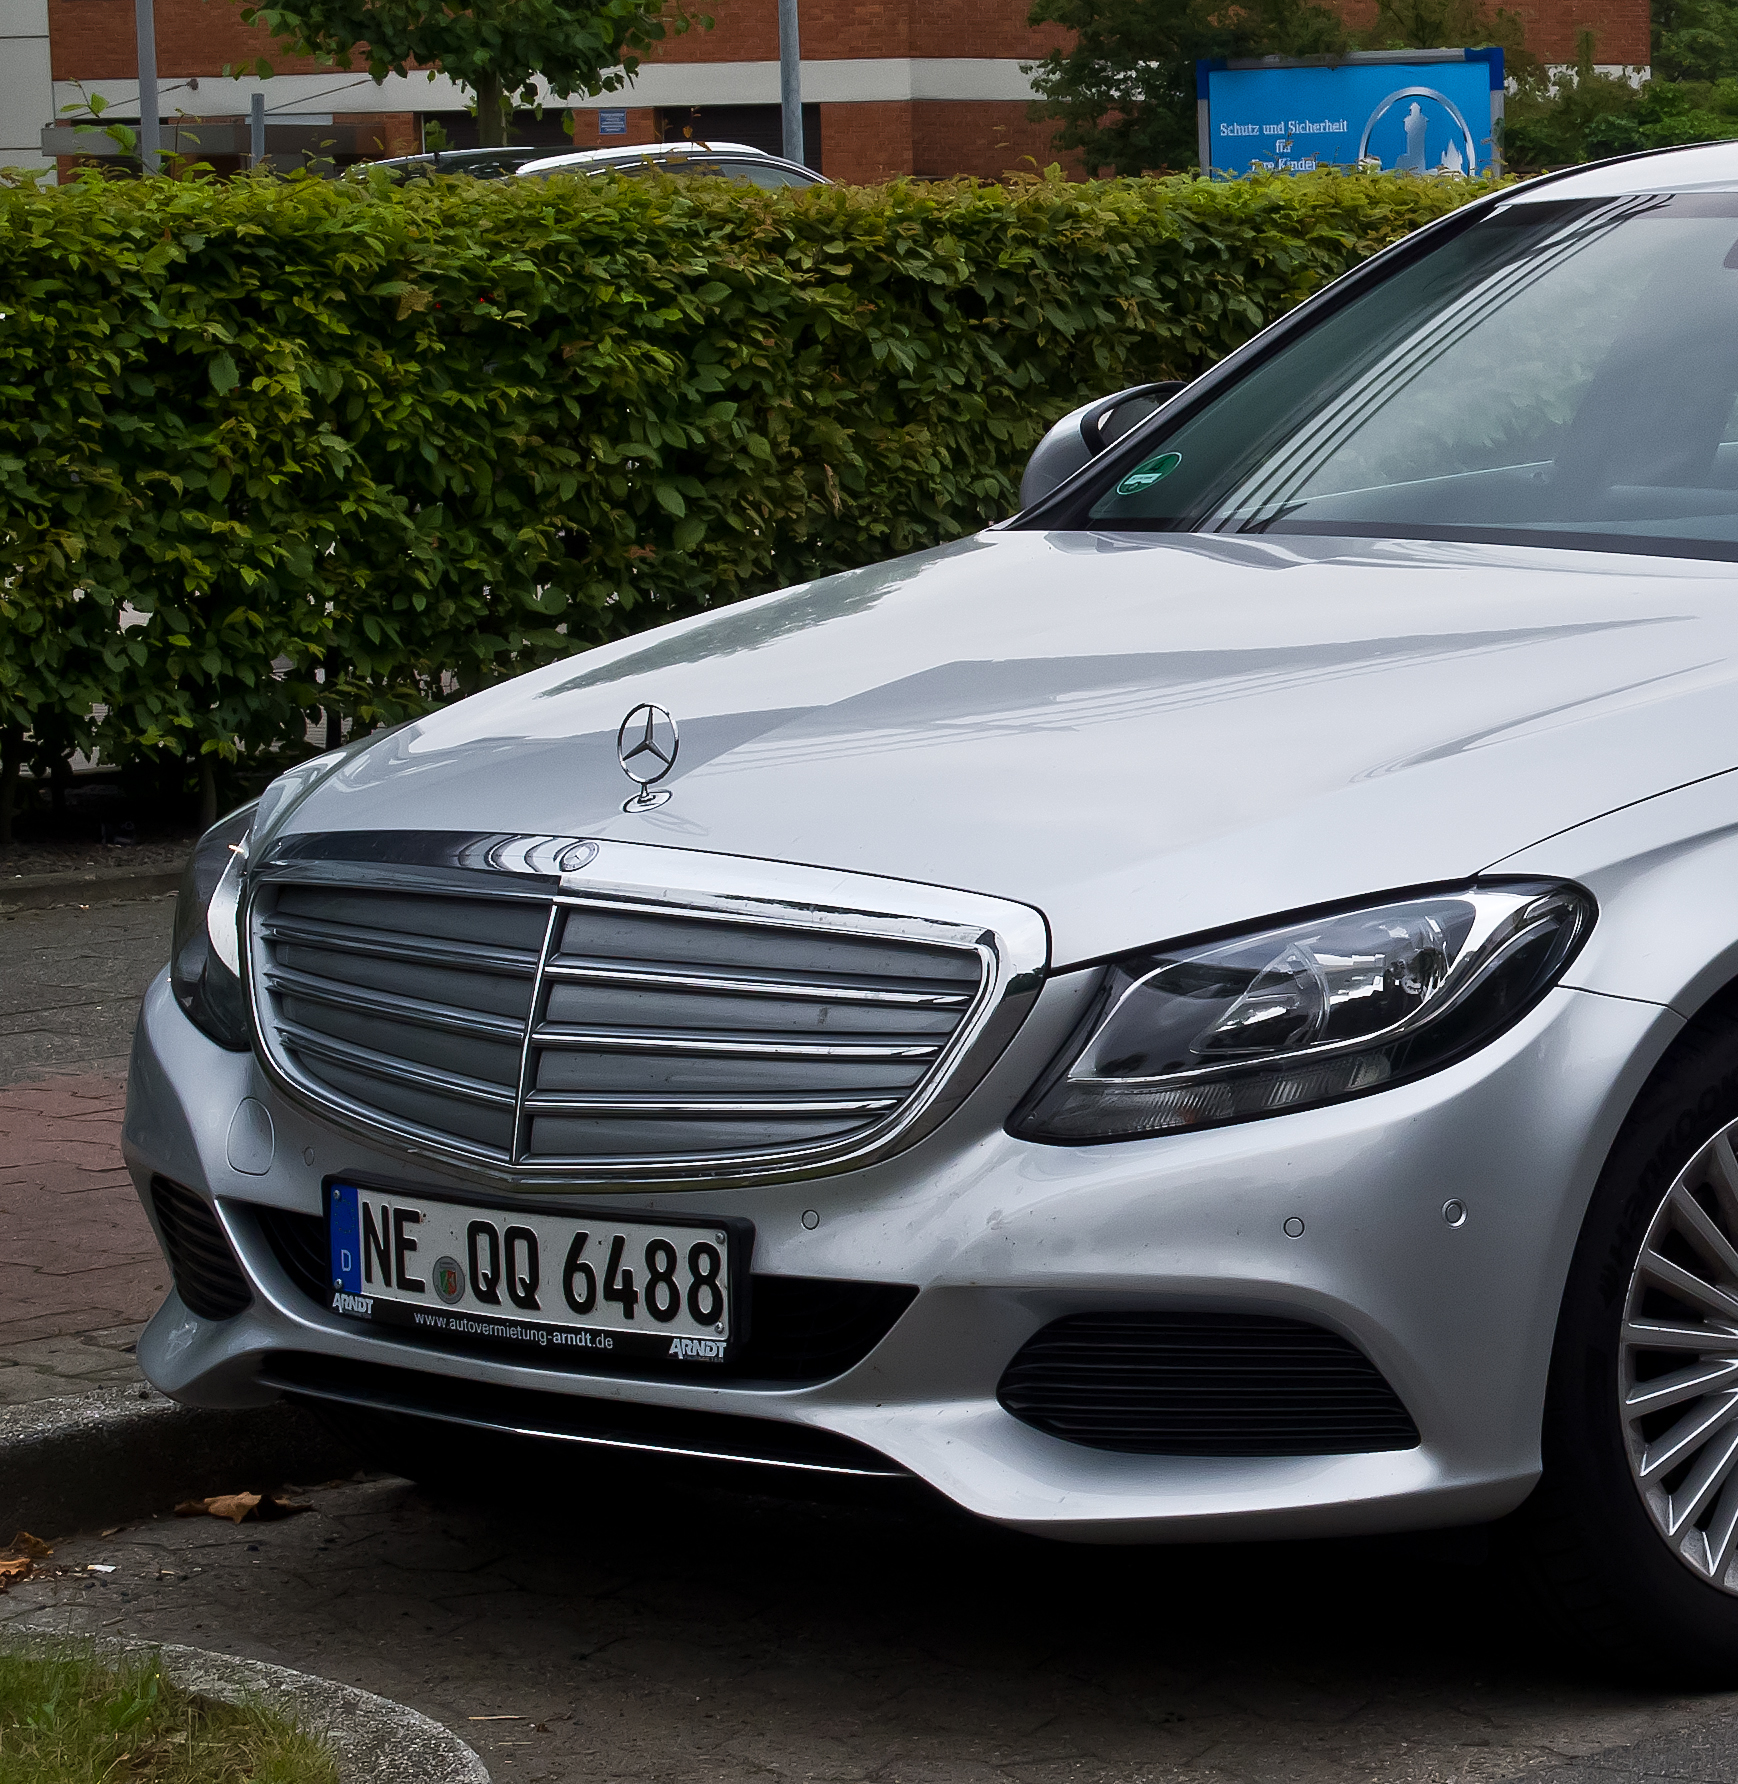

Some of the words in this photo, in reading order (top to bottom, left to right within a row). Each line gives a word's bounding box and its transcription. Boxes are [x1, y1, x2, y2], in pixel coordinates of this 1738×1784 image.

[1220, 122, 1260, 136] Schutz
[1263, 121, 1285, 135] und
[1288, 119, 1347, 134] Sicherheit
[340, 1249, 352, 1272] D
[361, 1201, 426, 1294] NE
[466, 1219, 542, 1310] QQ
[562, 1230, 725, 1326] 6488
[332, 1293, 374, 1315] ARNDT
[413, 1312, 614, 1349] www.autovermietung-arndt.de
[669, 1338, 727, 1360] ARNDT
